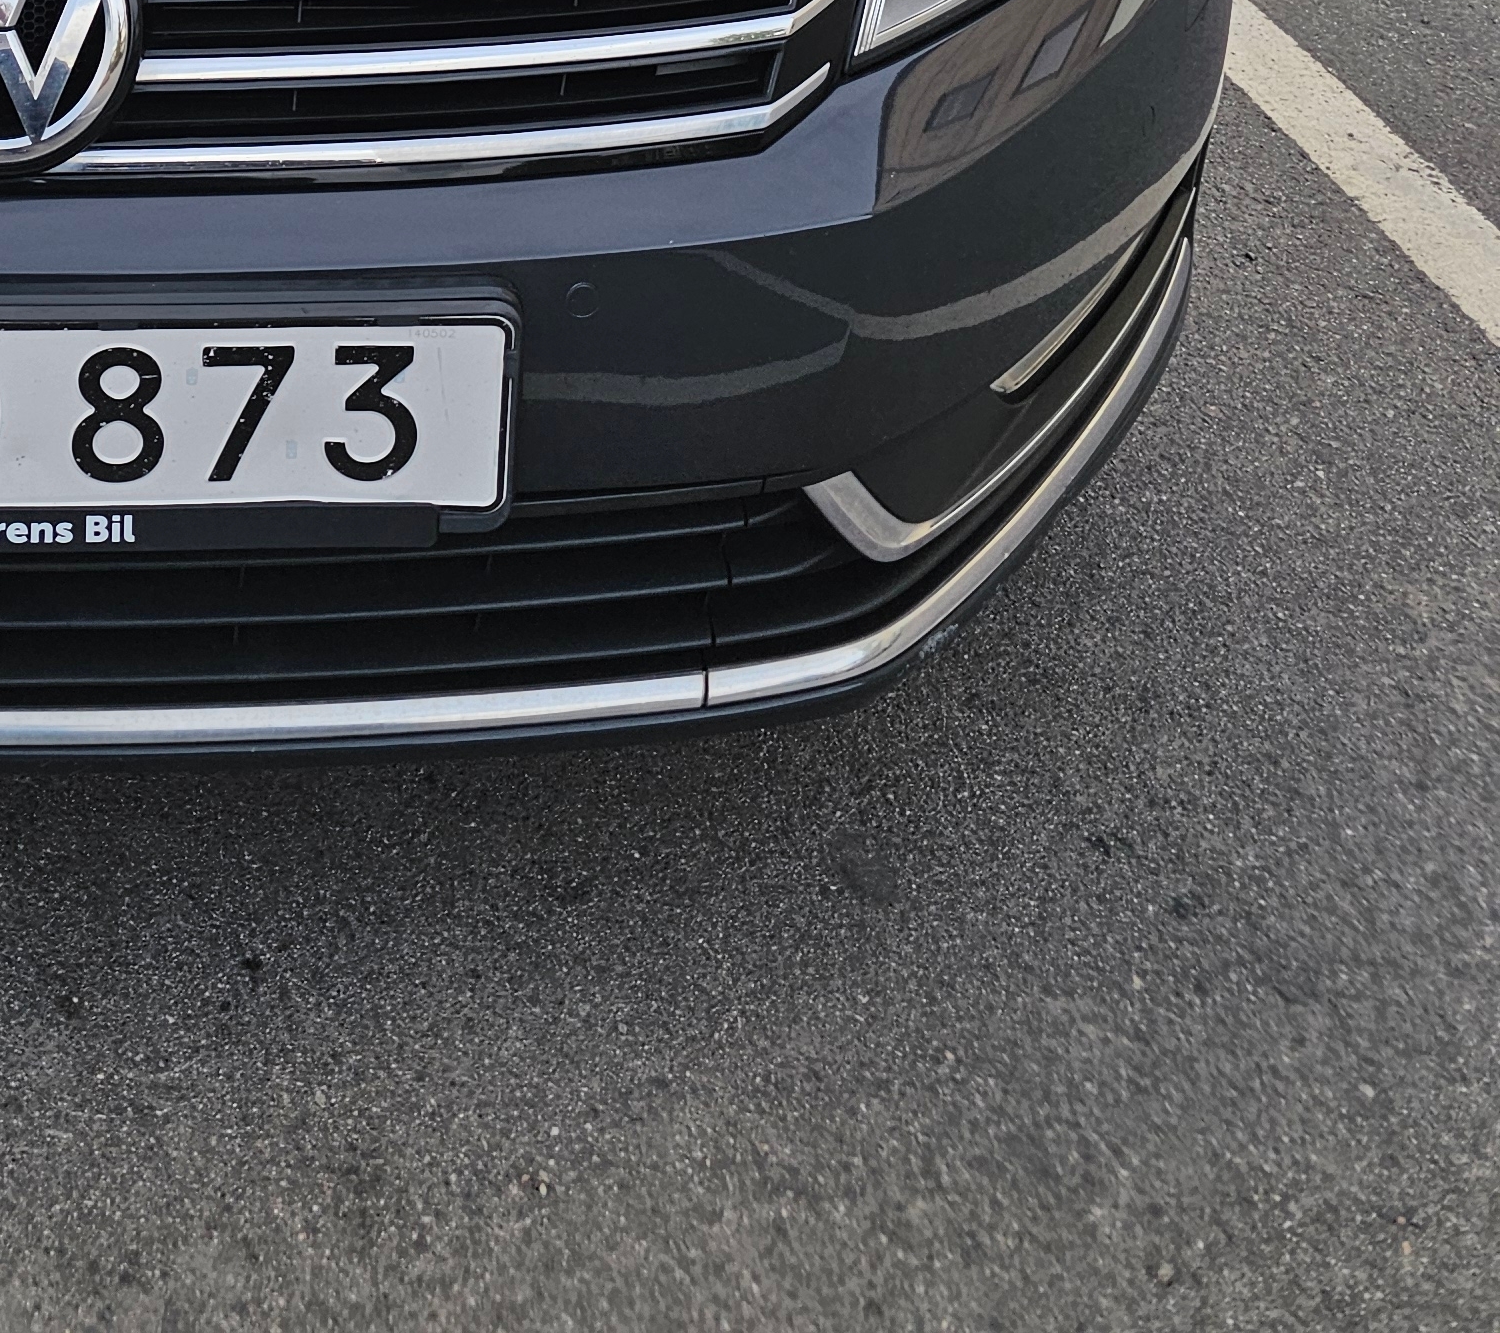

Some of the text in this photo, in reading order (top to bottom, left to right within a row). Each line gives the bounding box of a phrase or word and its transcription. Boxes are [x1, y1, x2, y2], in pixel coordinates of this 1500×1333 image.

[408, 328, 456, 339] 140502
[70, 344, 419, 483] 873
[85, 514, 136, 544] Bil
